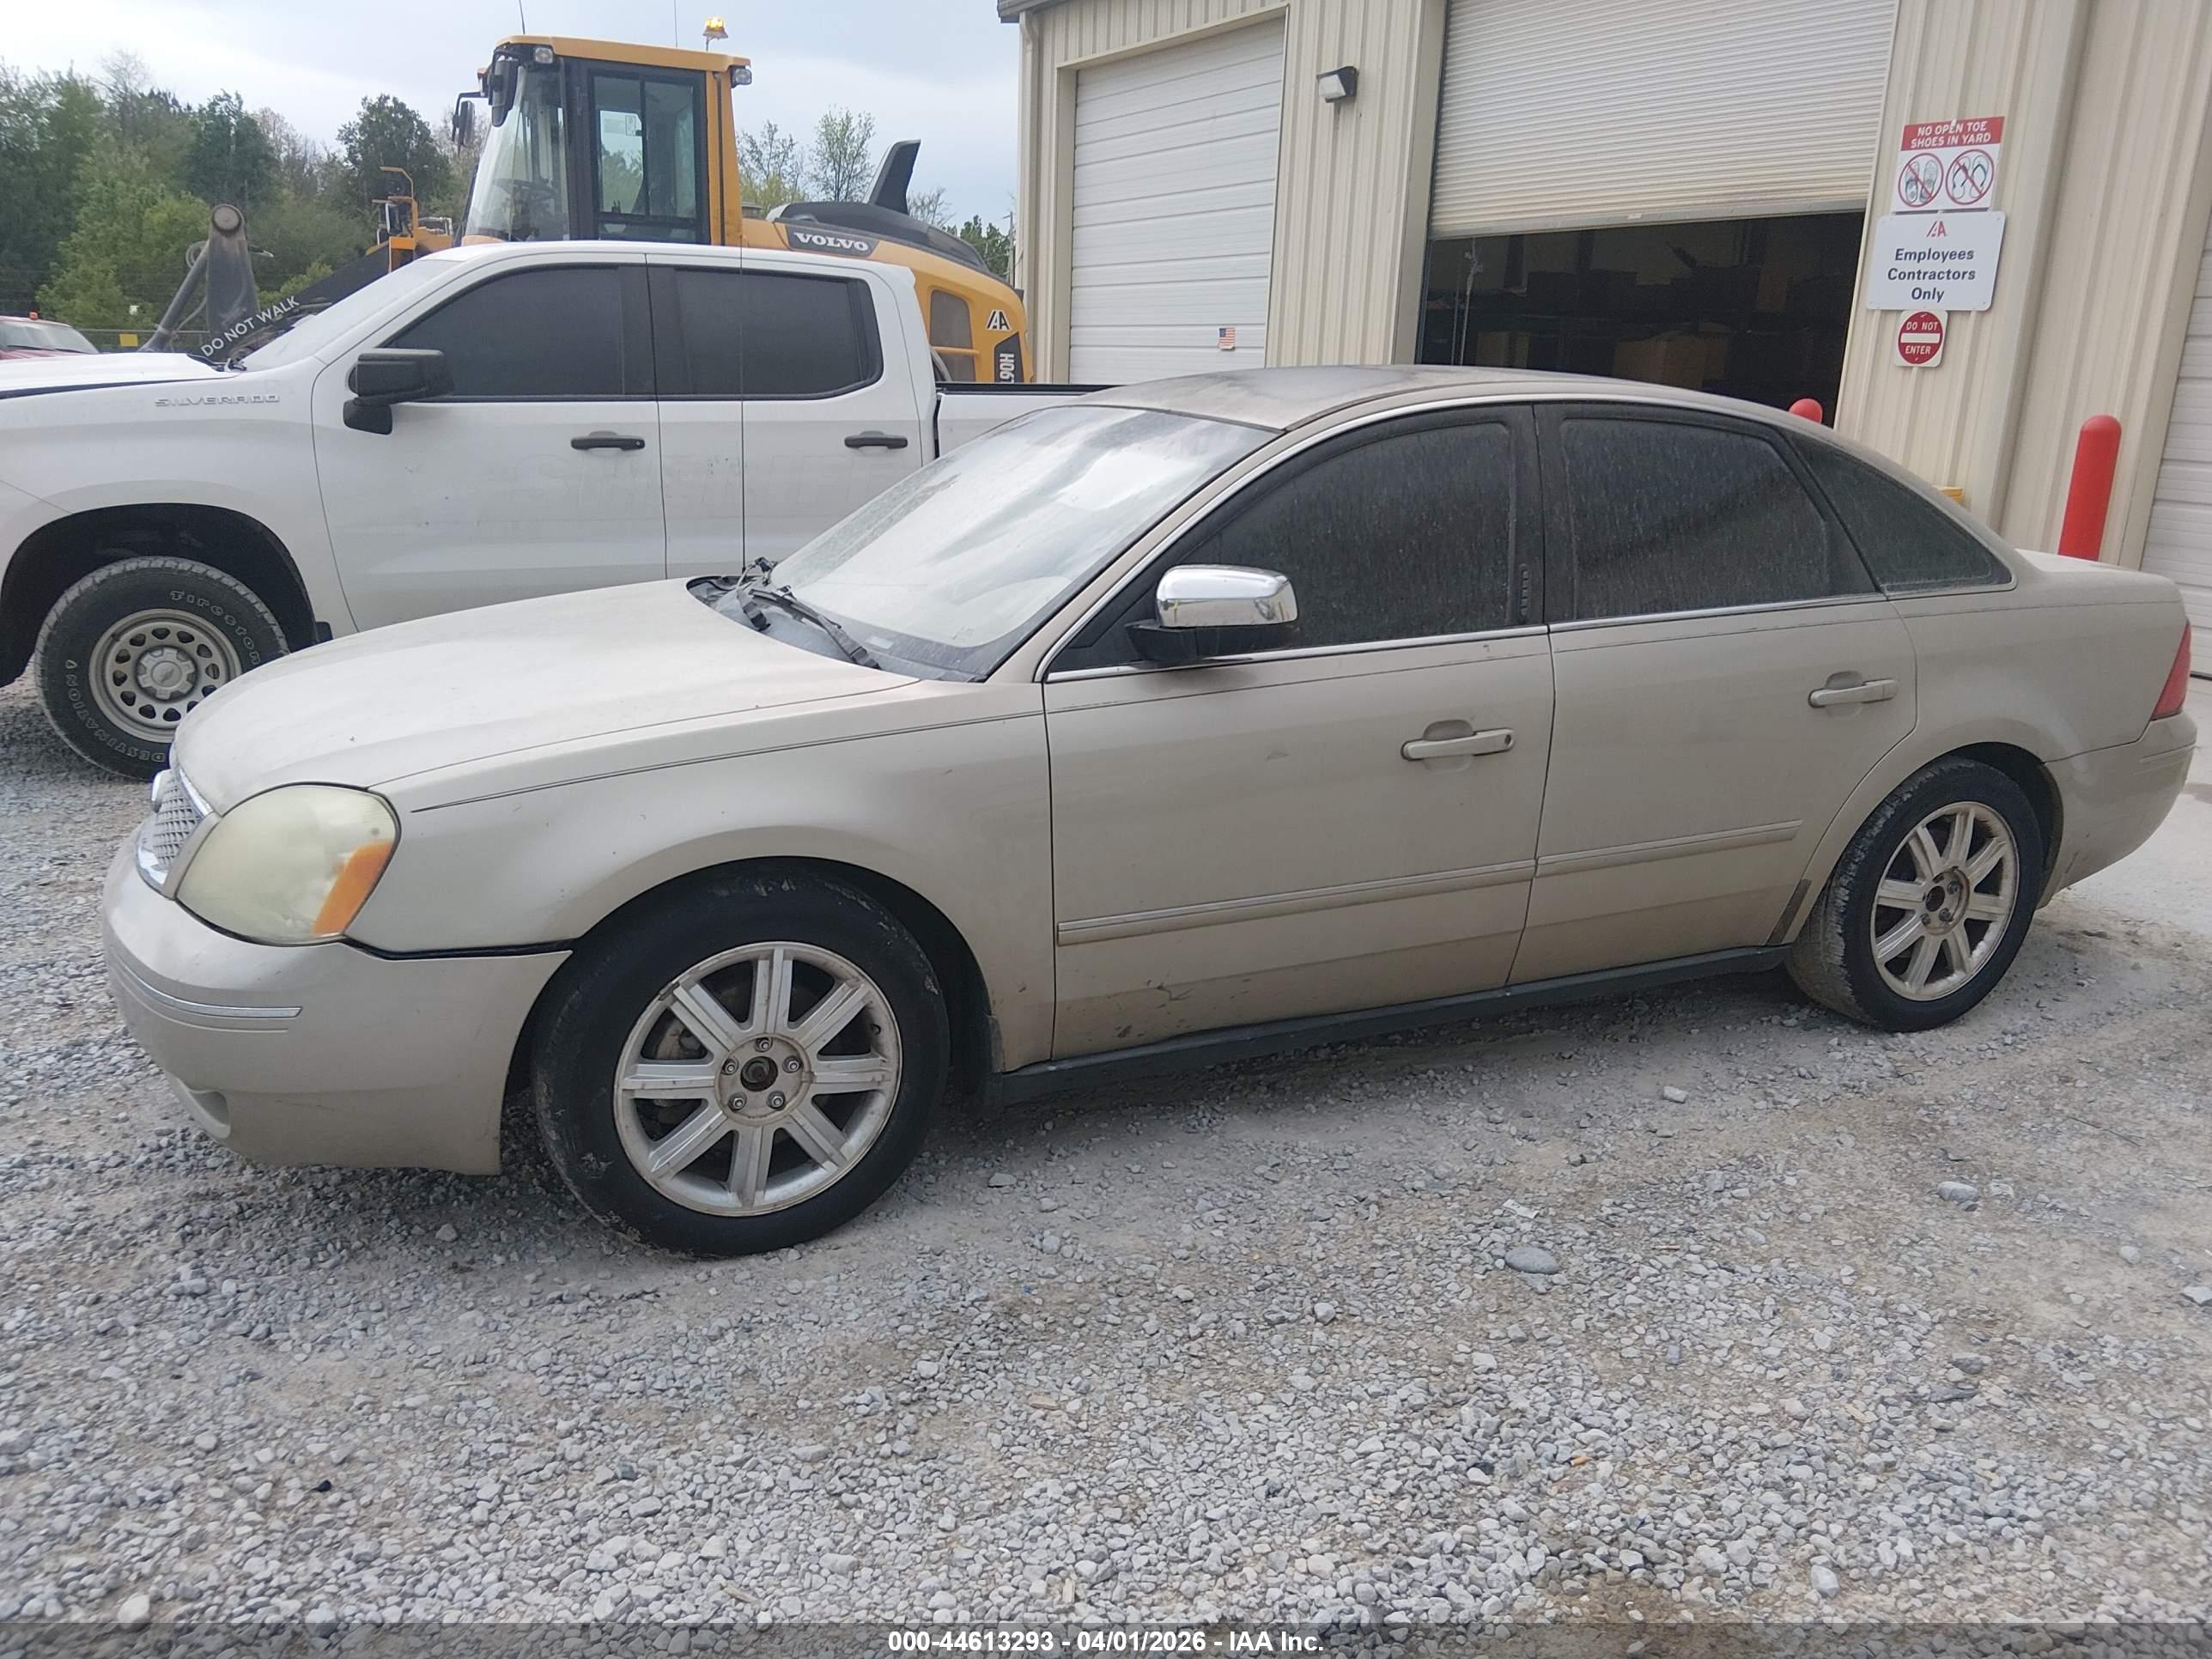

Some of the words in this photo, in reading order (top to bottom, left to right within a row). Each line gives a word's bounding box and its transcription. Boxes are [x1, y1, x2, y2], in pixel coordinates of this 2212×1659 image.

[1917, 125, 1933, 137] NO
[1935, 123, 1963, 134] OPEN
[1967, 121, 1987, 132] TOE
[1911, 137, 1945, 149] SHOES
[1948, 136, 1958, 145] IN
[1960, 132, 1991, 144] YARD
[794, 232, 869, 252] VOLVO
[1894, 247, 1974, 264] Employees
[1887, 268, 1976, 281] Contractors
[1911, 287, 1945, 302] Only
[200, 337, 224, 356] DO
[224, 318, 255, 342] NOT
[256, 295, 300, 323] WALK
[1906, 322, 1917, 331] DO
[1922, 321, 1938, 331] NOT
[1905, 345, 1930, 355] ENTER
[155, 395, 280, 407] SILVERADO
